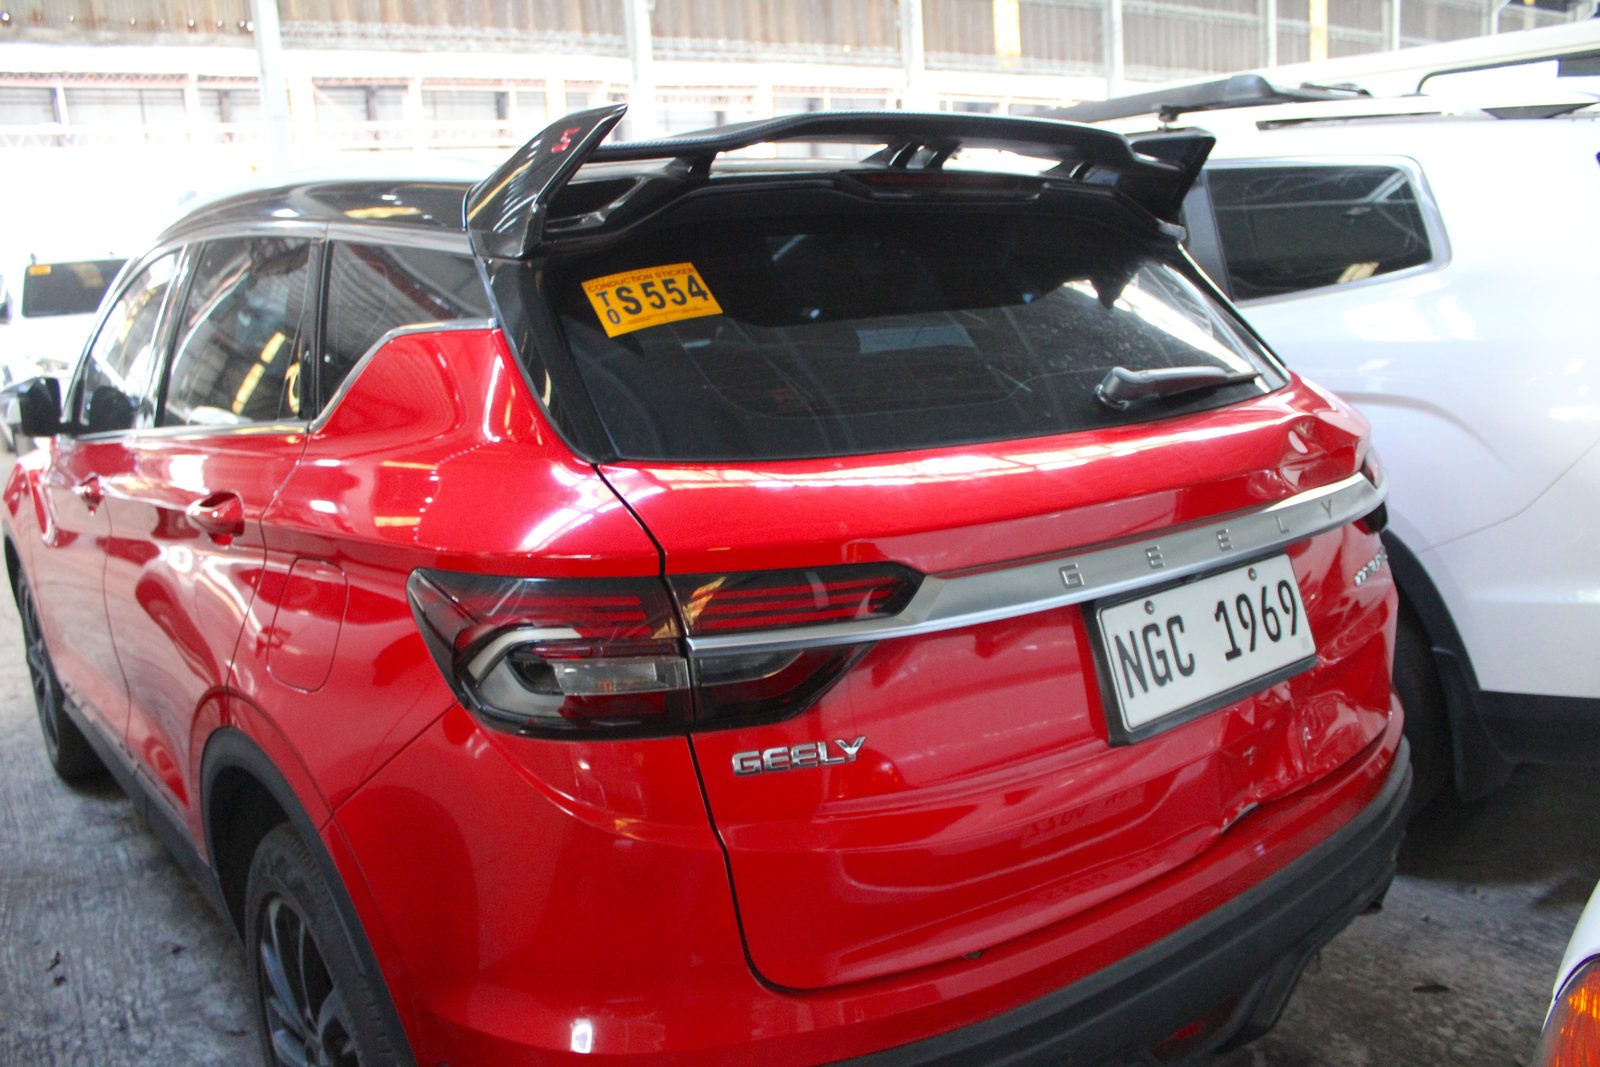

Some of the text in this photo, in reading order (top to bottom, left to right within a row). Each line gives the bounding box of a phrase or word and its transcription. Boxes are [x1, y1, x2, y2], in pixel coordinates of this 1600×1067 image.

[588, 267, 695, 293] CONDUCTION STICKER
[615, 274, 709, 315] S554
[1058, 499, 1333, 589] GEELY
[1114, 579, 1298, 699] NGC 1969
[732, 735, 867, 777] GEELY
